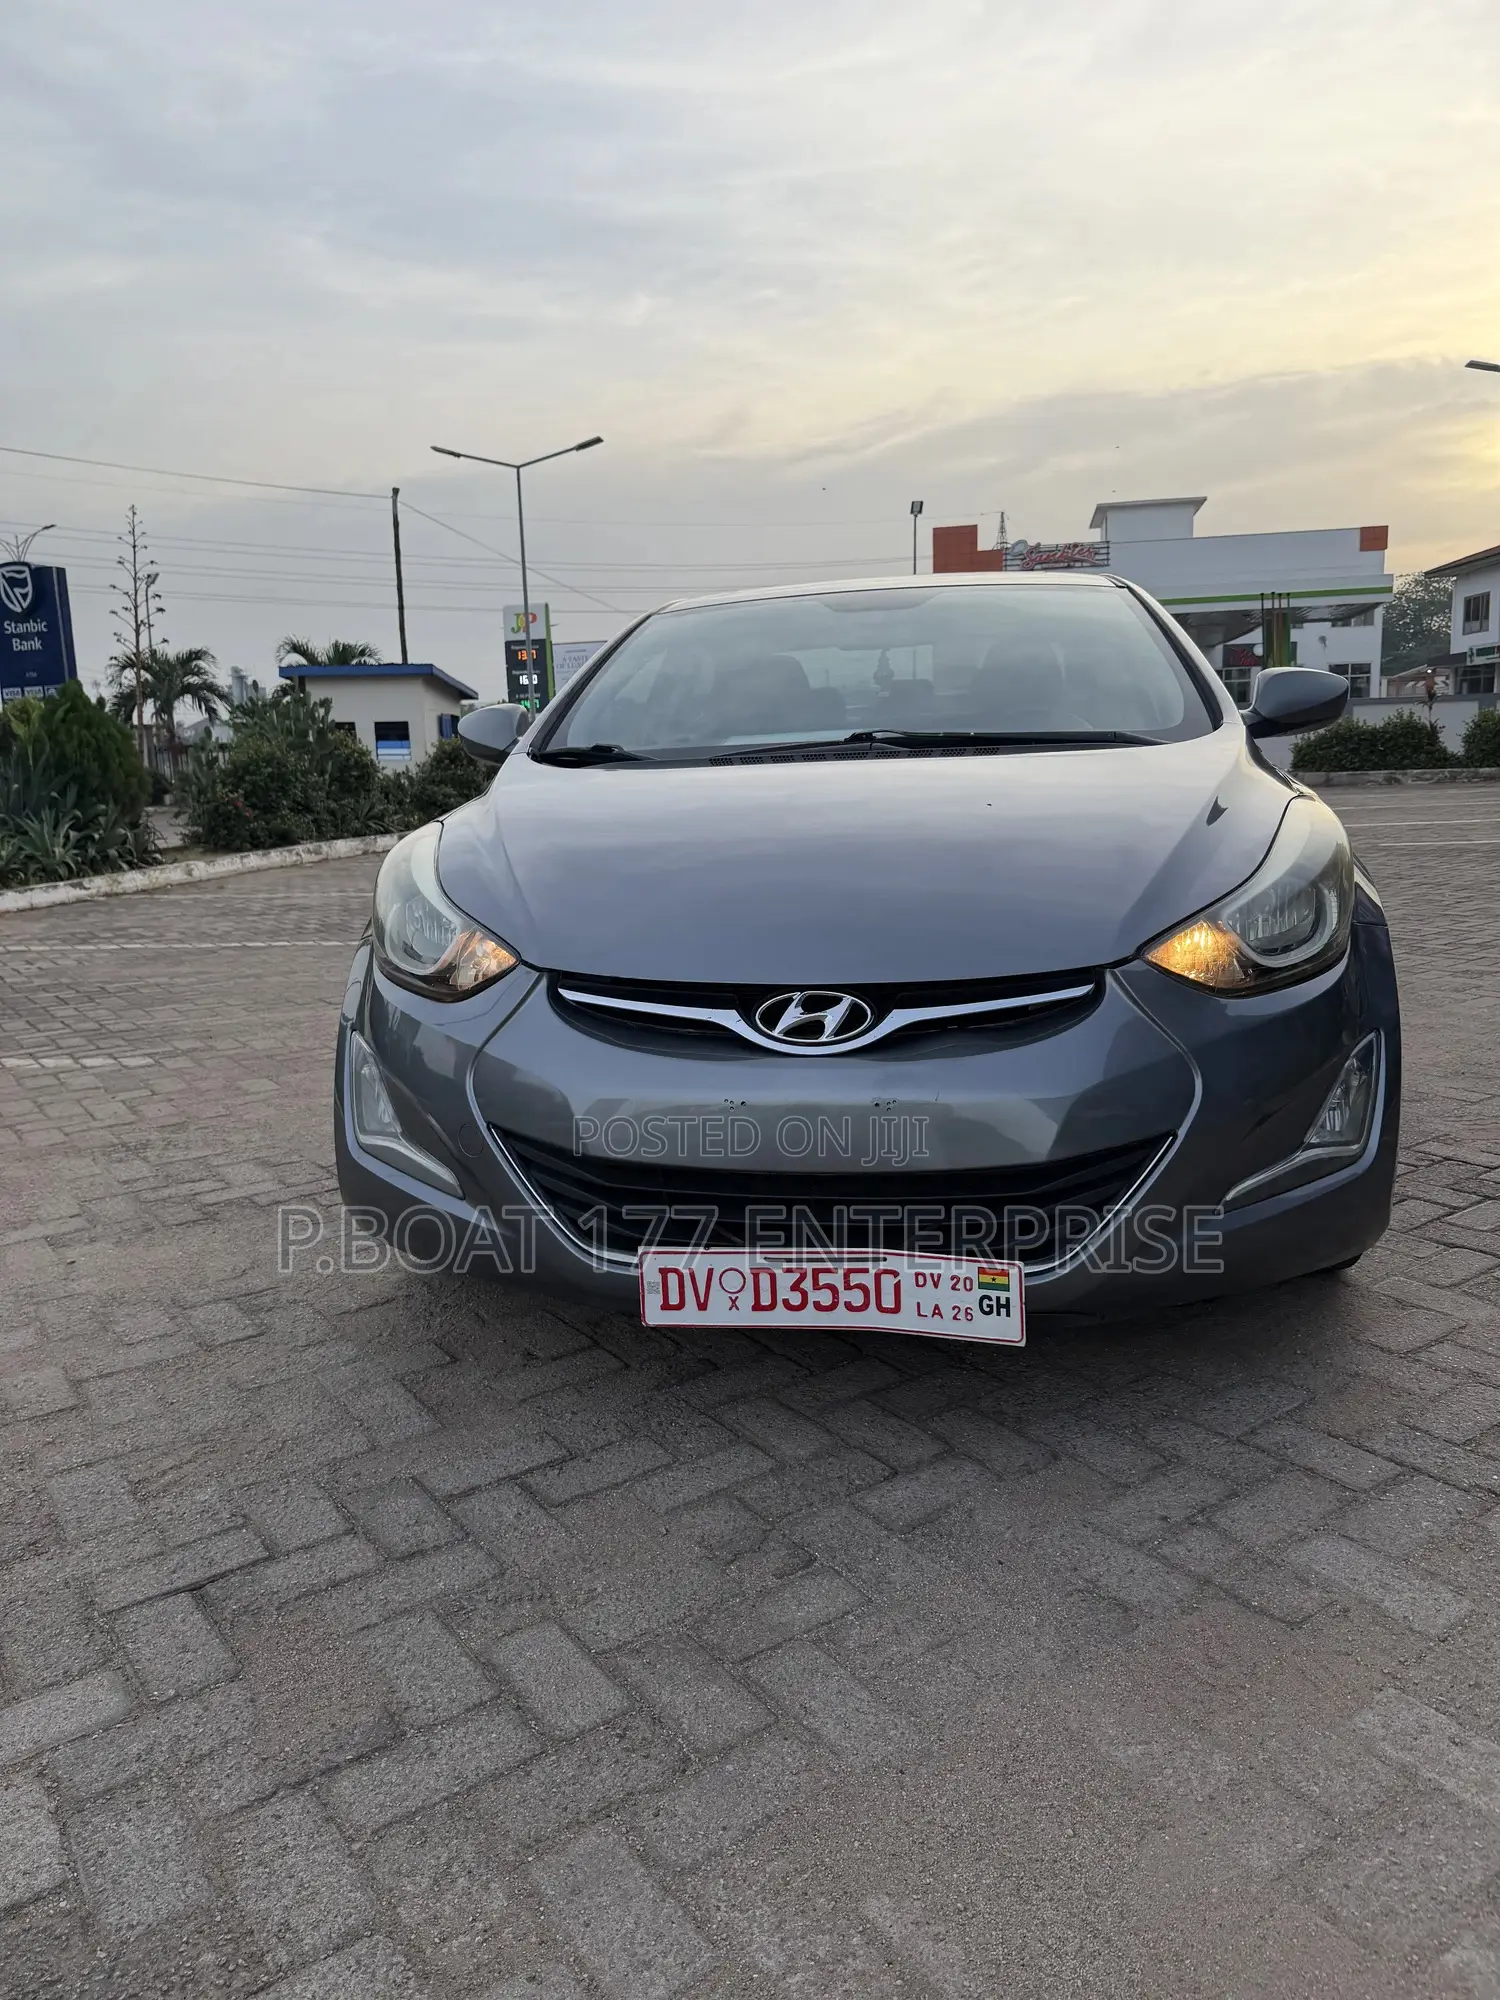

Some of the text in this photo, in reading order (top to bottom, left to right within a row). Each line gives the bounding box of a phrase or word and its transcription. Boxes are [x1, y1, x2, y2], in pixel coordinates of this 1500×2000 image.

[4, 619, 48, 634] Stanbic
[12, 637, 43, 651] Bank
[658, 1267, 714, 1312] DV
[749, 1267, 902, 1315] D3550
[914, 1271, 974, 1292] DV 20
[916, 1301, 974, 1321] LA 26
[978, 1294, 1011, 1317] GH
